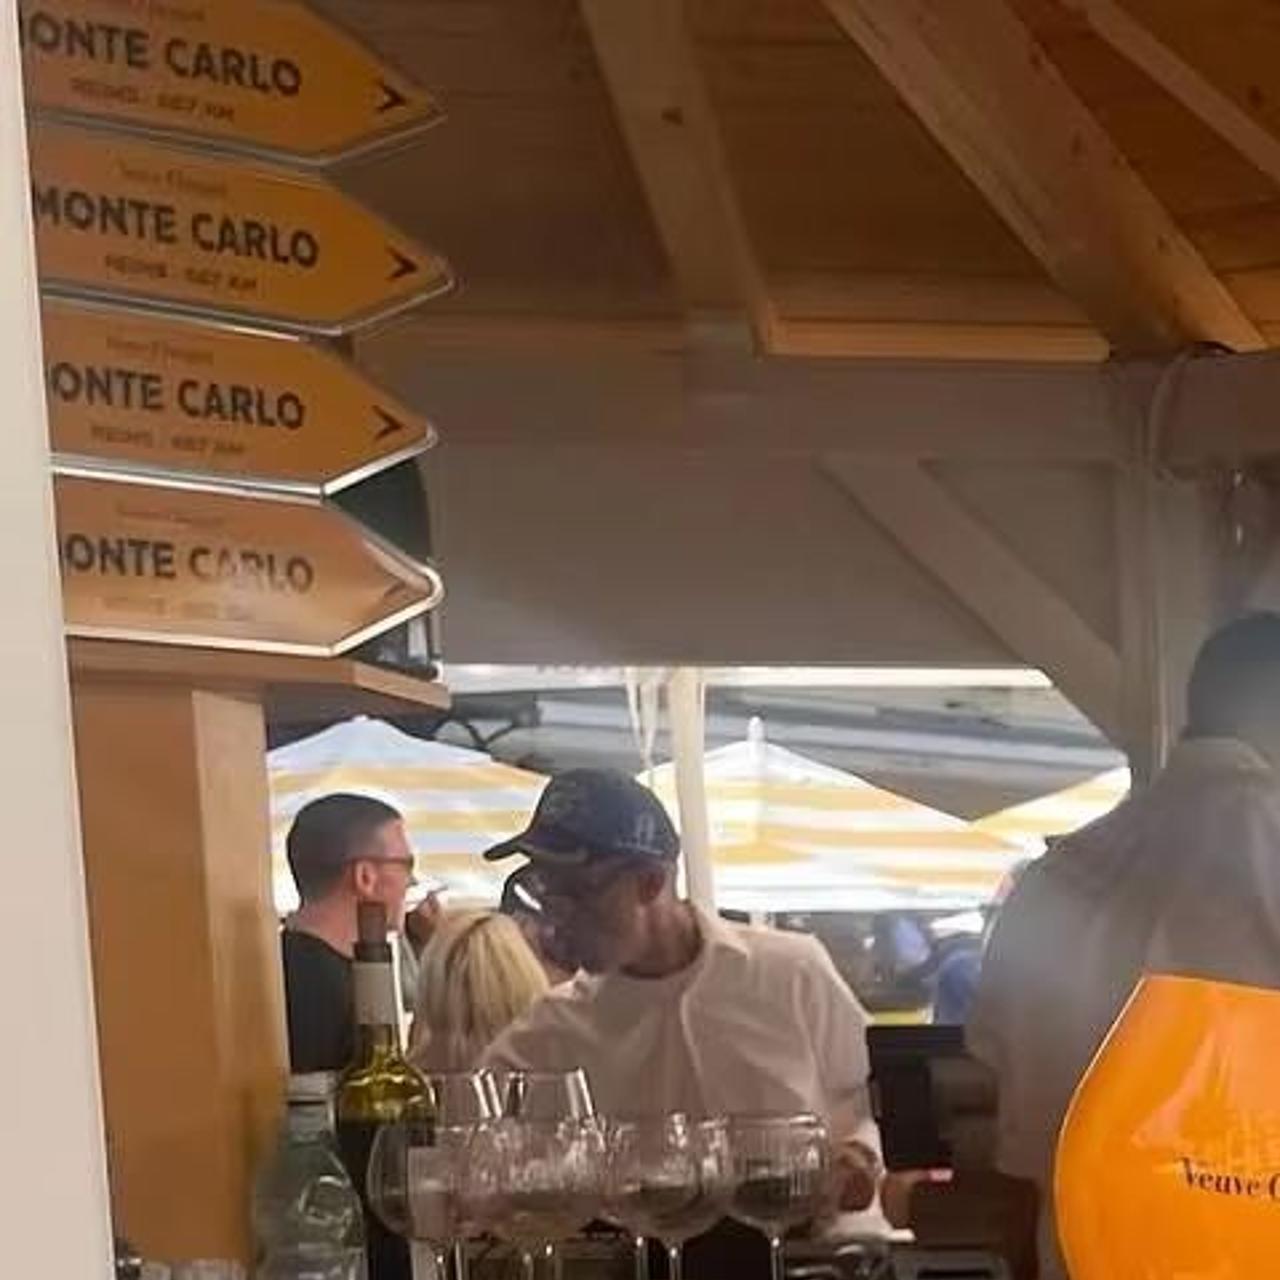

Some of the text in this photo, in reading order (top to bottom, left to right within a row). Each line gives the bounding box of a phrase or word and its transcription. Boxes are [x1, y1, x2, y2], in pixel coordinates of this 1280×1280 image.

[28, 11, 150, 69] ONTE
[164, 38, 302, 97] CARLO
[190, 212, 319, 268] CARLO
[47, 361, 306, 430] ONTE CARLO
[60, 533, 177, 580] ONTE
[1177, 1156, 1260, 1196] Veuve
